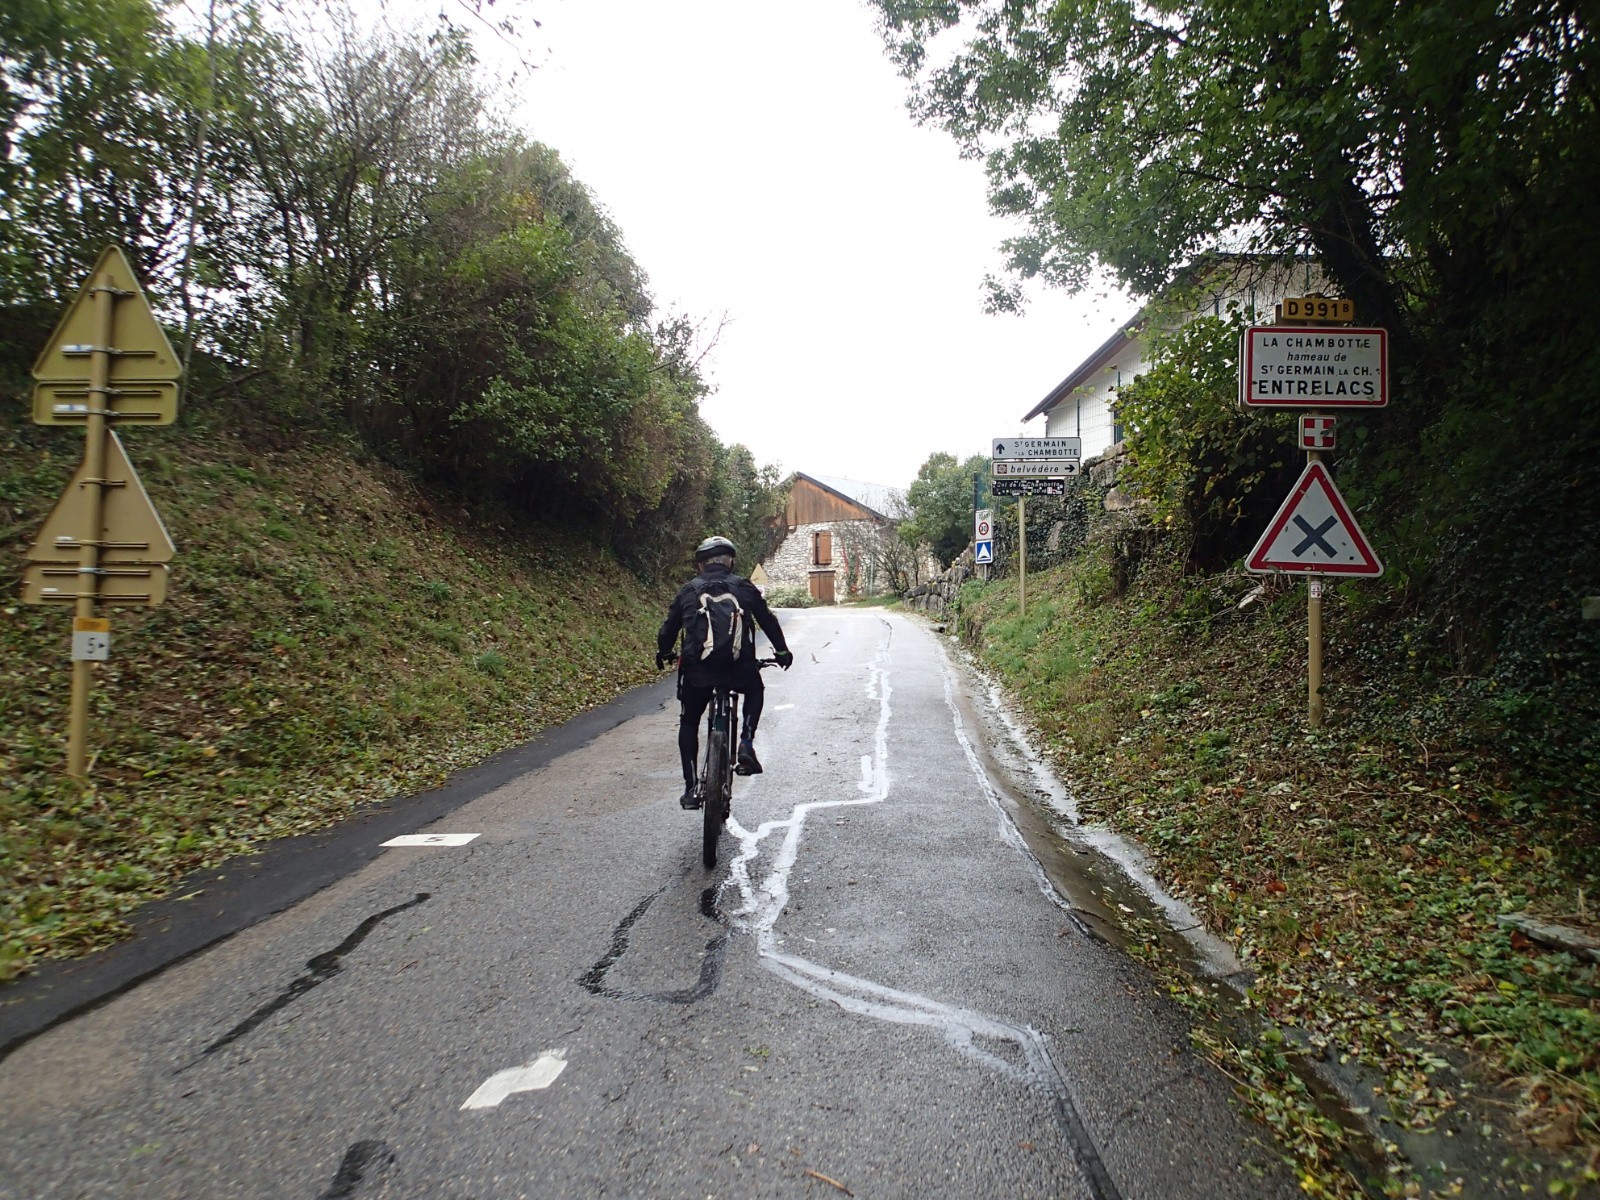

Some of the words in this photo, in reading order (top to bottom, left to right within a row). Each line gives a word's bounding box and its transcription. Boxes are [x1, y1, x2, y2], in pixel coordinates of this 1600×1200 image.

[1288, 302, 1299, 316] D
[1263, 338, 1278, 347] LA
[1286, 338, 1371, 348] CHAMBOTTE
[1287, 352, 1330, 362] hameau
[1334, 352, 1347, 362] de
[1277, 366, 1335, 376] GERMAIN
[1353, 367, 1373, 376] CH.
[1258, 380, 1375, 396] ENTRELACS
[1024, 440, 1067, 448] GERMAIN
[1010, 463, 1059, 473] belvédère
